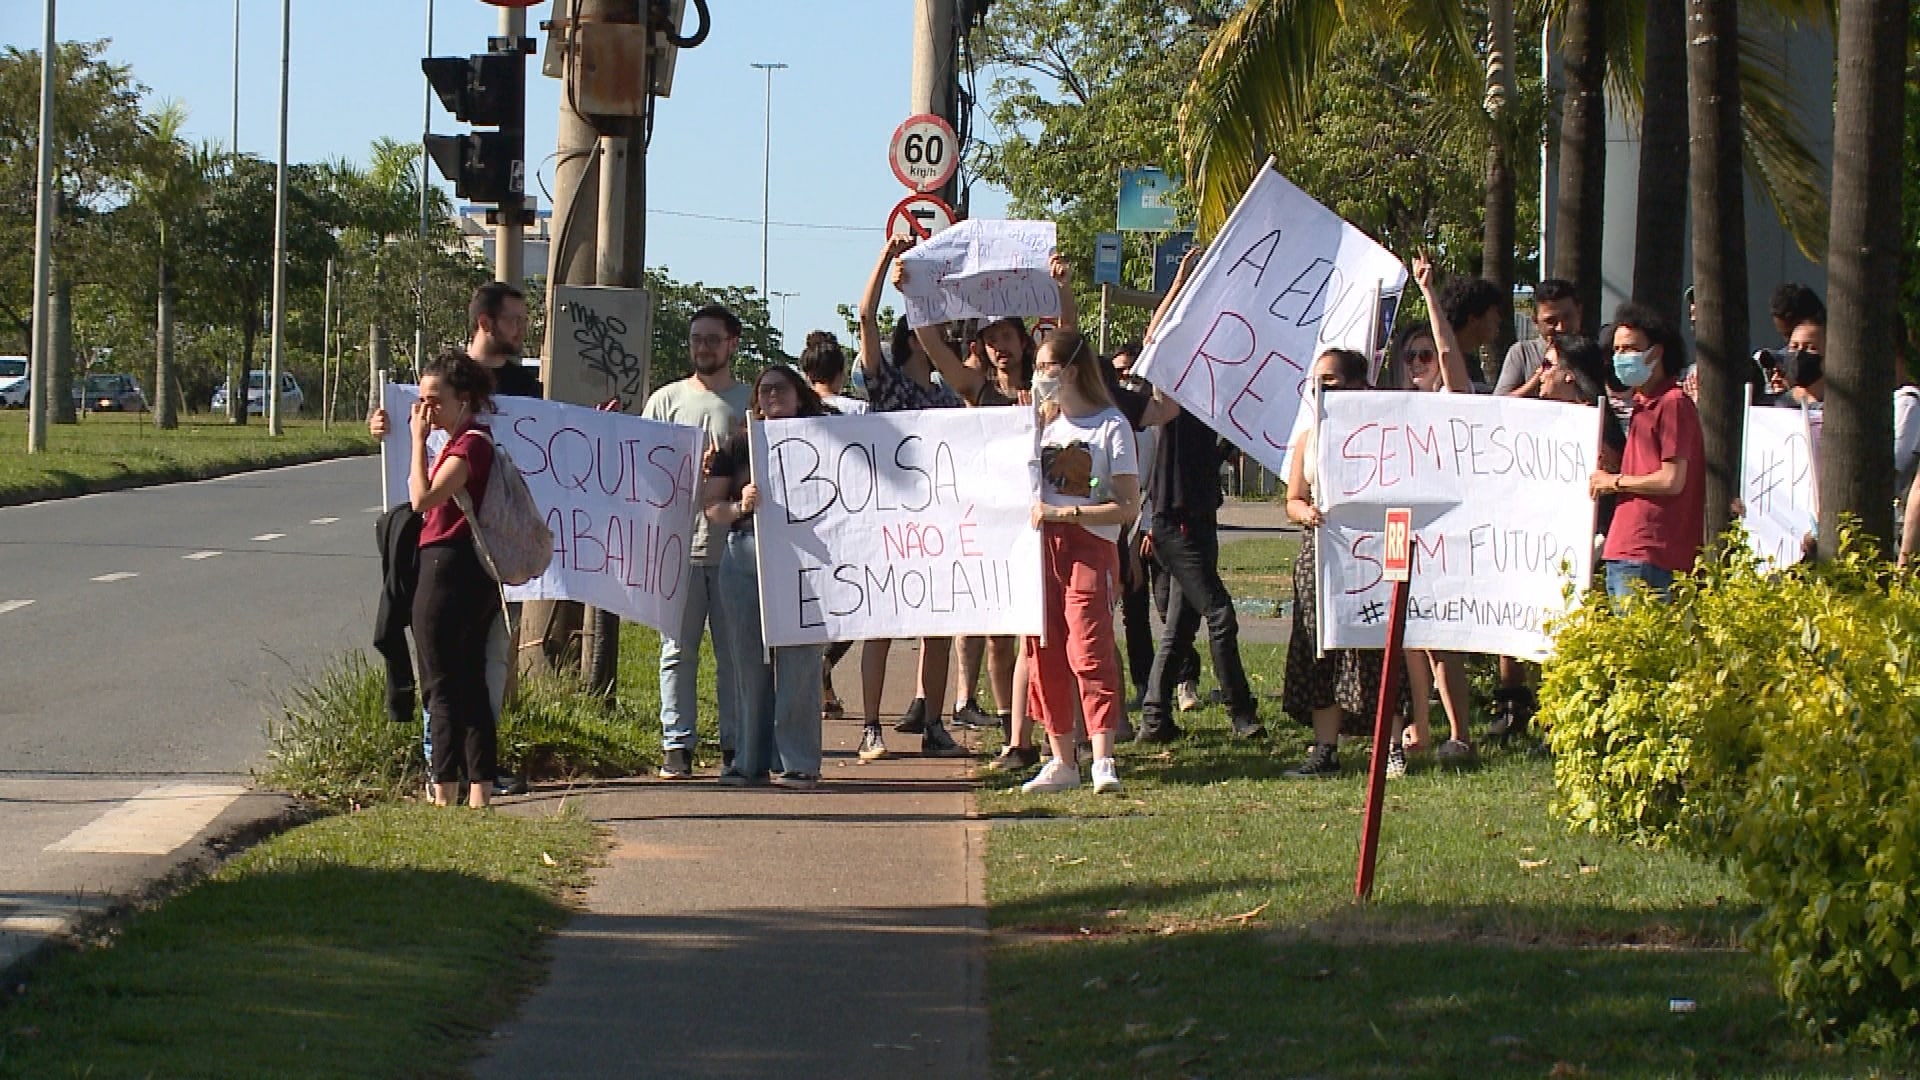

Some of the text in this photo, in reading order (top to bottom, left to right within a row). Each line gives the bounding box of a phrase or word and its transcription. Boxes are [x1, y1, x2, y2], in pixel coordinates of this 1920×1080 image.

[905, 133, 943, 165] 60
[909, 165, 936, 178] km/h
[1226, 228, 1281, 288] A
[1174, 311, 1316, 451] RES
[498, 411, 694, 514] SQUISA
[770, 435, 960, 525] BOLSA
[1342, 417, 1587, 496] SEM PESQUISA
[1750, 431, 1812, 517] #P
[545, 507, 682, 600] ABALHO
[882, 503, 984, 561] NÃO É
[1344, 523, 1579, 594] SM FUTURO
[1387, 521, 1406, 561] RR
[798, 559, 1012, 629] ESMOLA!!!
[1357, 595, 1560, 634] #AGUEMINABOL
